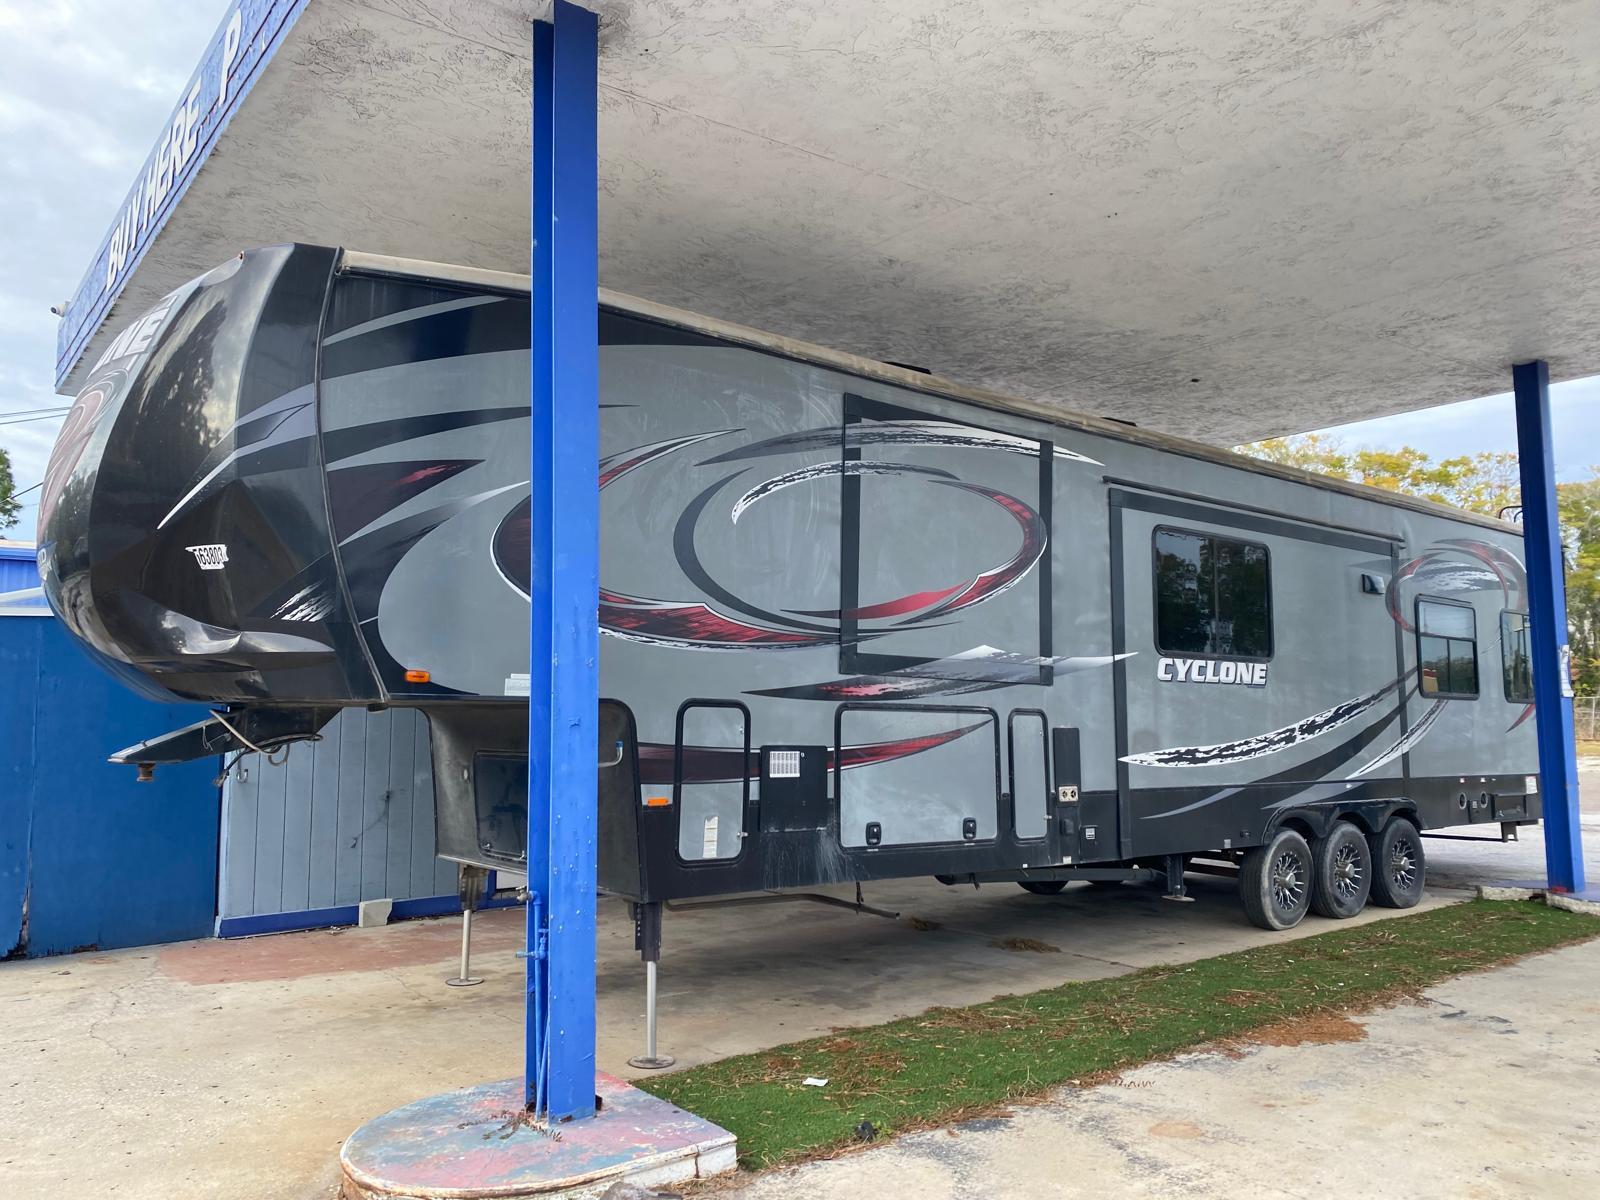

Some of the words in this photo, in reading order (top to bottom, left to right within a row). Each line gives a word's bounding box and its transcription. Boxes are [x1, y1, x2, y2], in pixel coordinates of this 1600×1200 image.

[106, 180, 146, 292] BUY
[142, 75, 202, 232] HERE
[1157, 657, 1268, 686] CYCLONE
